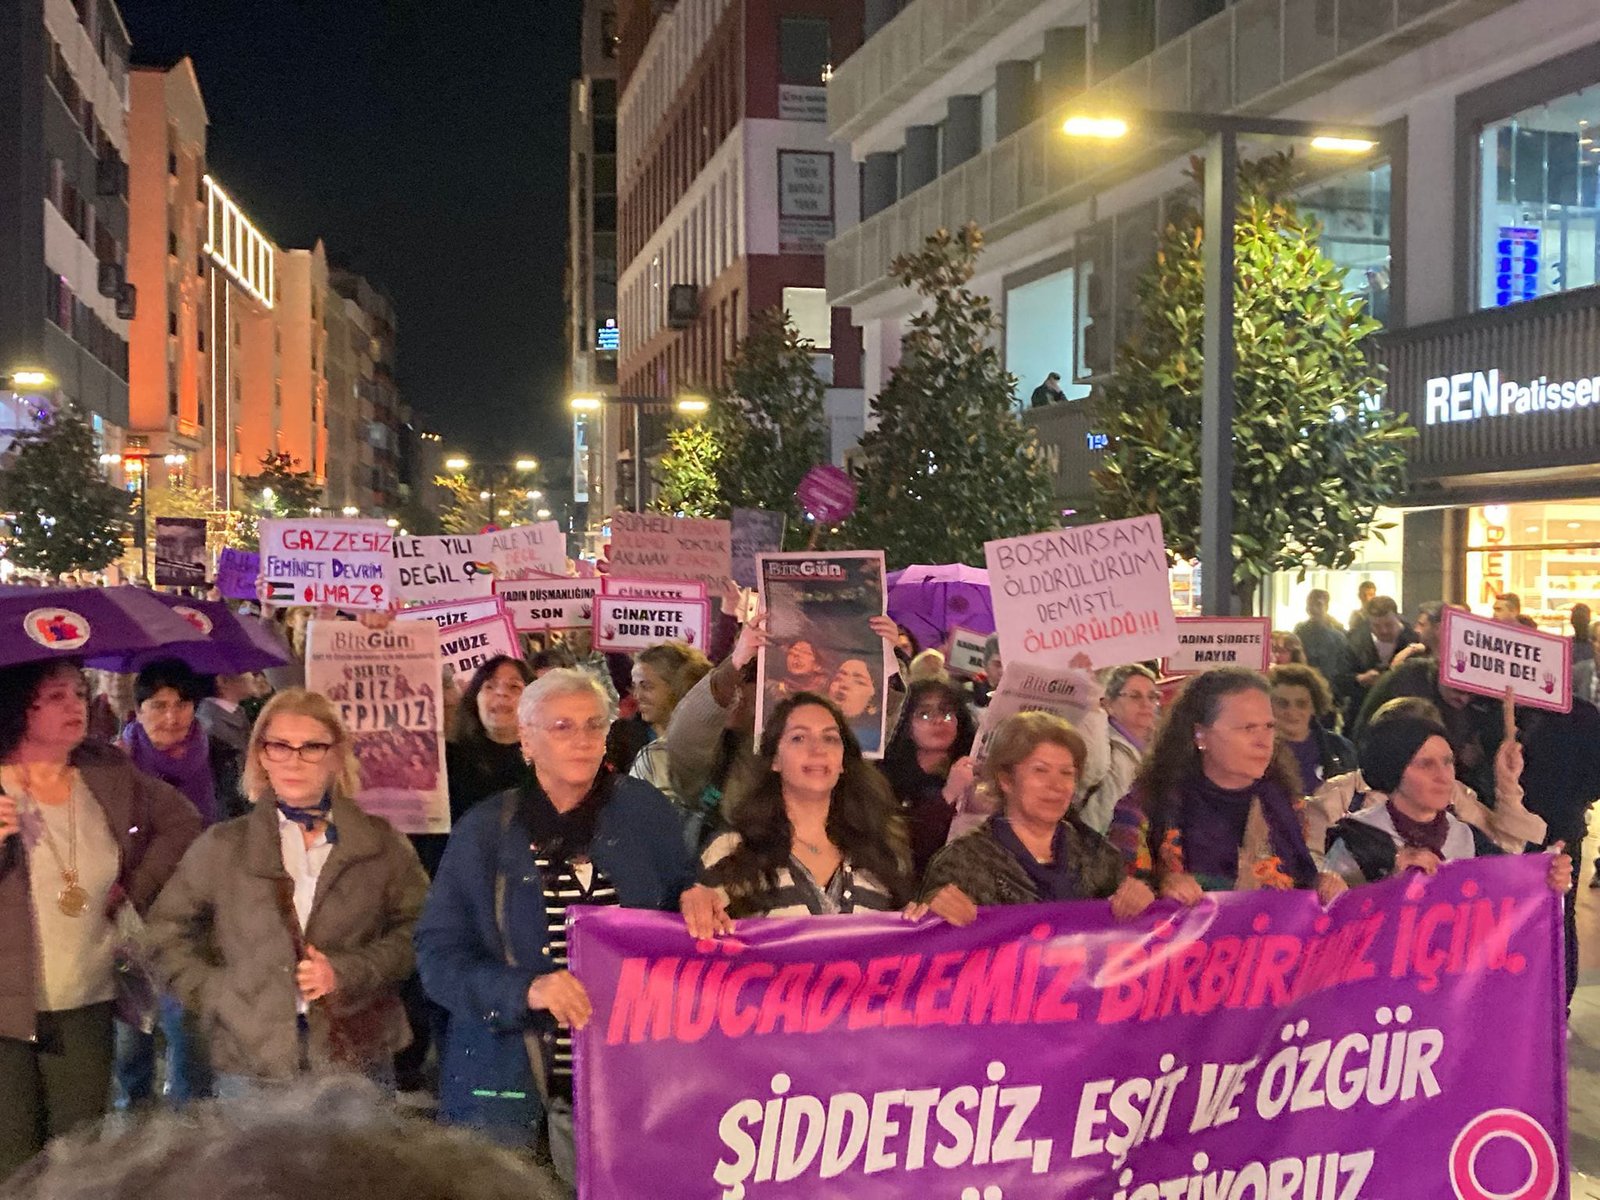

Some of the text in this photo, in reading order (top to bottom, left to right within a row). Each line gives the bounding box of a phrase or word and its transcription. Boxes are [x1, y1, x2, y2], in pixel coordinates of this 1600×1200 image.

[1426, 369, 1499, 424] REN
[440, 538, 472, 555] YILI
[996, 521, 1156, 570] BOŞANIRSAM
[398, 562, 461, 586] DEĞİL
[1003, 549, 1160, 597] ÖLDÜRÜLÜRÜM
[530, 608, 563, 619] SON
[612, 607, 683, 622] CİNAYETE
[618, 623, 678, 637] DUR DE!
[1178, 634, 1215, 644] ADINA
[1194, 650, 1236, 662] HAYIR
[1463, 629, 1541, 662] CİNAYETE
[1470, 652, 1537, 681] DUR DE!
[606, 880, 1527, 1045] MÜCADELEMİZ BİRBİRİMİZ İÇİN.
[713, 1005, 1444, 1200] ŞİDDETSİZ, EŞİT VE ÖZGÜR
